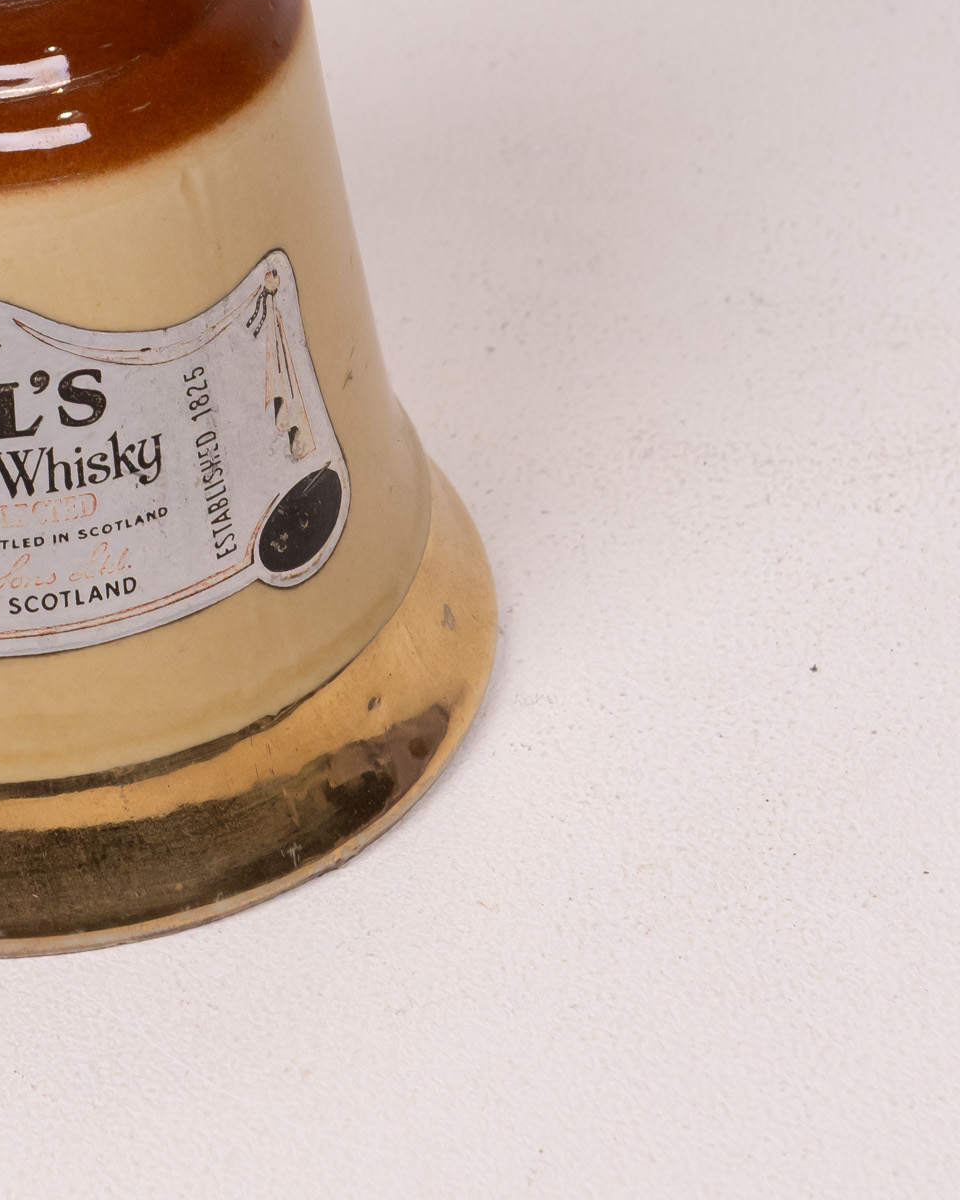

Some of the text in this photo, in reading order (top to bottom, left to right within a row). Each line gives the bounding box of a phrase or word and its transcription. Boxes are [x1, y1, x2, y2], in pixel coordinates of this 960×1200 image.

[183, 366, 237, 560] ESTABLISHED 1825
[52, 532, 70, 544] IN
[78, 506, 168, 539] SCOTLAND
[8, 576, 137, 615] SCOTLAND
